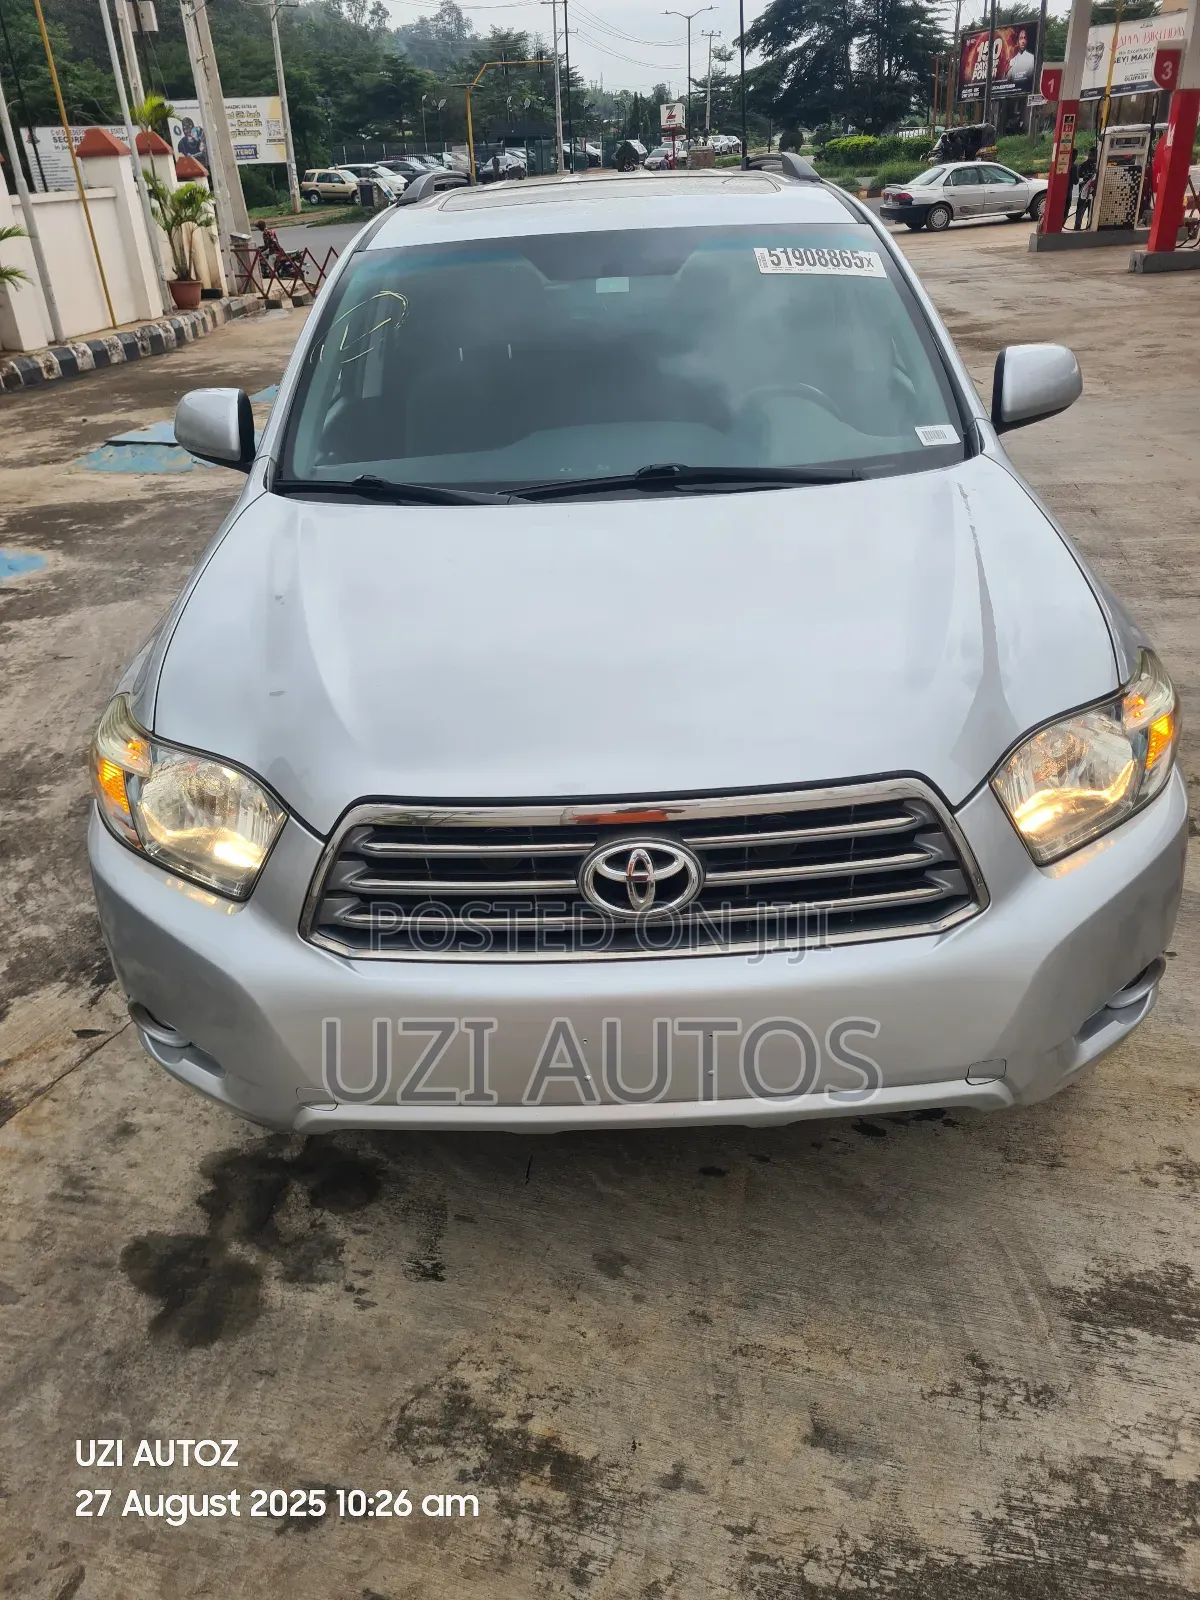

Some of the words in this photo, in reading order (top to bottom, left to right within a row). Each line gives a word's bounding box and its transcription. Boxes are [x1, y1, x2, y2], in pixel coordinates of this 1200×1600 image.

[1161, 61, 1173, 80] 3
[1047, 78, 1056, 93] 1
[766, 247, 865, 269] 51908865
